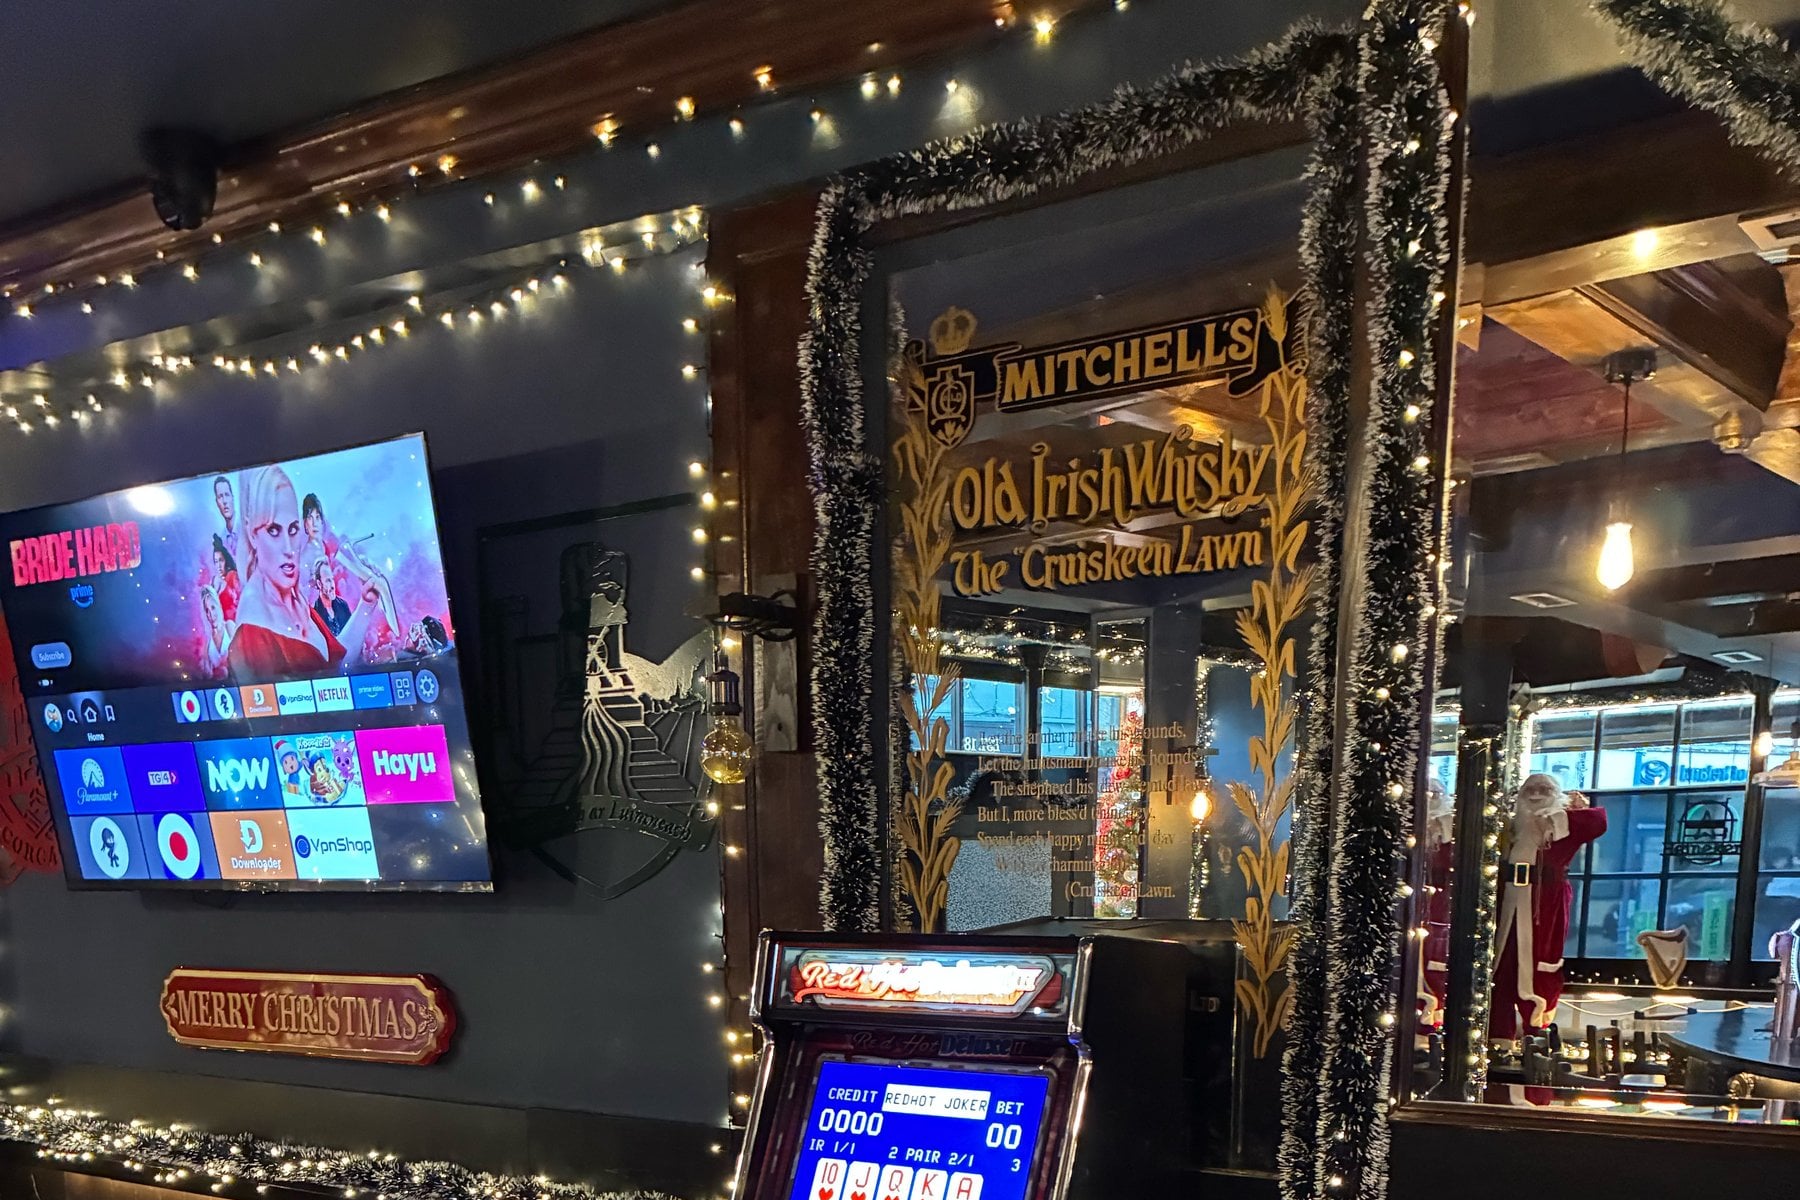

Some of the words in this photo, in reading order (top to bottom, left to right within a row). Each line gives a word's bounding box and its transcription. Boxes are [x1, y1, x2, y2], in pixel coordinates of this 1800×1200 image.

[1000, 317, 1255, 403] MITCHELL'S
[952, 457, 1027, 530] Old
[1030, 442, 1132, 533] Irish
[1121, 424, 1273, 516] Whisky
[10, 531, 77, 587] BRIDE
[75, 520, 141, 577] HARD
[950, 551, 1008, 597] The
[70, 583, 94, 600] prime
[38, 651, 65, 663] Subscribe
[286, 694, 313, 704] VpnShop
[317, 687, 348, 702] NETFLIX
[87, 732, 105, 742] Home
[206, 756, 270, 792] NOW
[372, 750, 436, 781] Hayu
[1001, 755, 1022, 771] the
[77, 787, 118, 805] Paramount+
[990, 780, 1015, 798] The
[1017, 777, 1073, 800] shepherd
[1075, 777, 1095, 795] his
[977, 805, 998, 822] But
[1002, 805, 1010, 824] I,
[1013, 808, 1044, 821] more
[310, 837, 372, 855] VpnShop
[1047, 830, 1084, 852] happy
[231, 856, 281, 870] Downloader
[801, 960, 859, 989] Red
[175, 989, 258, 1030] MERRY
[262, 991, 418, 1041] CHRISTMAS
[853, 1031, 894, 1049] Red
[902, 1033, 940, 1055] Hot
[828, 1087, 878, 1104] CREDIT
[884, 1091, 936, 1108] REDHOT
[943, 1096, 988, 1113] JOKER
[995, 1100, 1024, 1116] BET
[818, 1107, 884, 1137] 0000
[985, 1122, 1022, 1150] 00
[833, 1140, 856, 1155] 1/1
[888, 1146, 899, 1160] 2
[905, 1147, 941, 1164] PAIR
[948, 1151, 975, 1167] 2/1
[1010, 1158, 1021, 1172] 3
[821, 1161, 839, 1185] 10
[855, 1166, 872, 1188] J
[888, 1169, 904, 1192] Q
[921, 1172, 939, 1197] K
[956, 1177, 973, 1200] A
